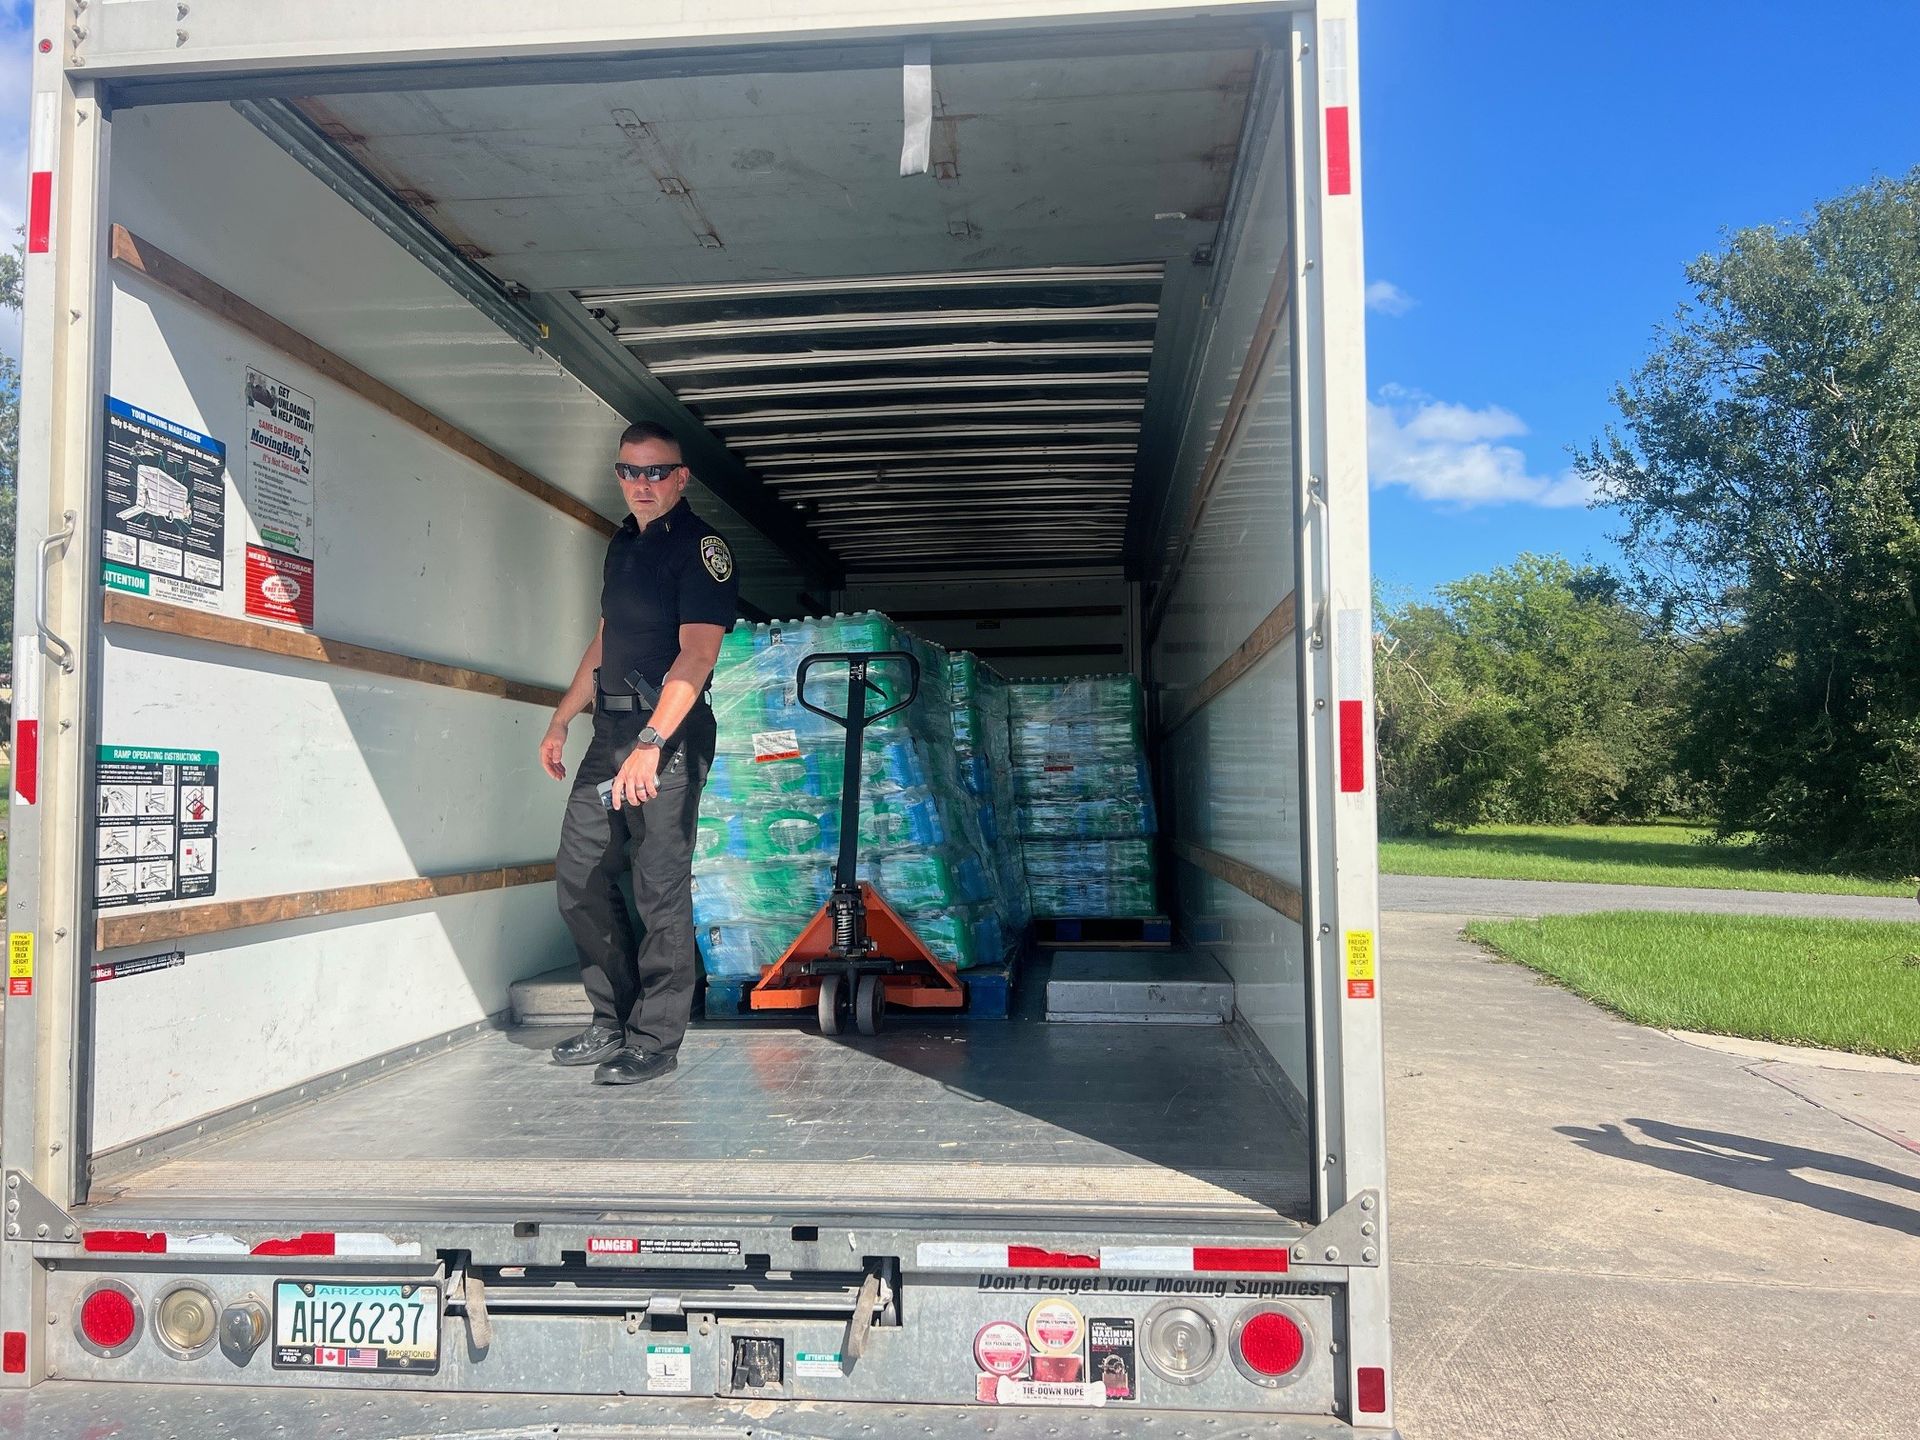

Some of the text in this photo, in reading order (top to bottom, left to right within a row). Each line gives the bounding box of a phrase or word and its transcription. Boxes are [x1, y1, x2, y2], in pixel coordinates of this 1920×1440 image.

[279, 386, 290, 398] GET
[278, 398, 310, 420] UNLOADING
[130, 408, 147, 423] YOUR
[147, 414, 168, 432] MOVING
[168, 423, 183, 438] MADE
[278, 409, 314, 434] HELP TODAY!
[258, 419, 304, 446] SAME DAY SERVICE
[248, 551, 266, 562] NEED
[103, 570, 146, 589] ATTENTION
[113, 749, 202, 763] RAMP OPERATING INSTRUCTIONS
[591, 1239, 634, 1252] DANGER
[319, 1287, 400, 1296] ARIZONA
[979, 1274, 1329, 1299] Don't Forget Your Moving Supplies!
[291, 1301, 424, 1345] AH26237
[1091, 1329, 1133, 1338] MAXIMUM
[1091, 1337, 1134, 1346] SECURITY
[282, 1355, 298, 1363] PAID
[388, 1350, 431, 1359] APPORTIONED
[1022, 1386, 1085, 1397] TIE-DOWN ROPE
